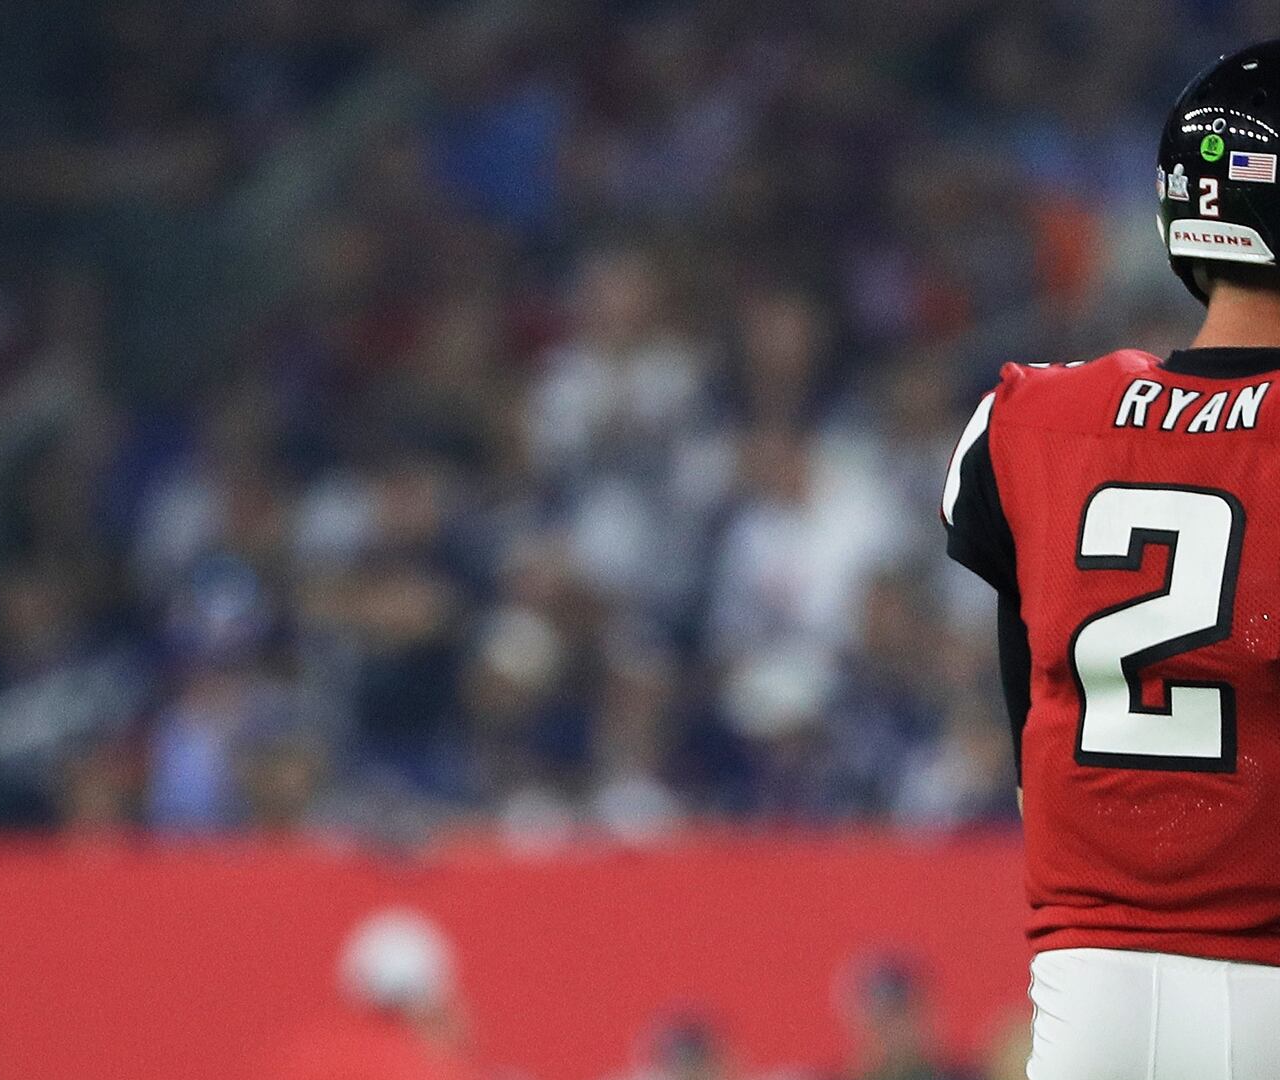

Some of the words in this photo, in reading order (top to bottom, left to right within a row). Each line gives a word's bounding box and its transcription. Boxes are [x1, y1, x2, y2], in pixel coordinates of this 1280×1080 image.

[1199, 177, 1219, 217] 2
[1174, 231, 1252, 247] FALCONS
[1114, 378, 1271, 433] RYAN
[1071, 481, 1244, 773] 2
